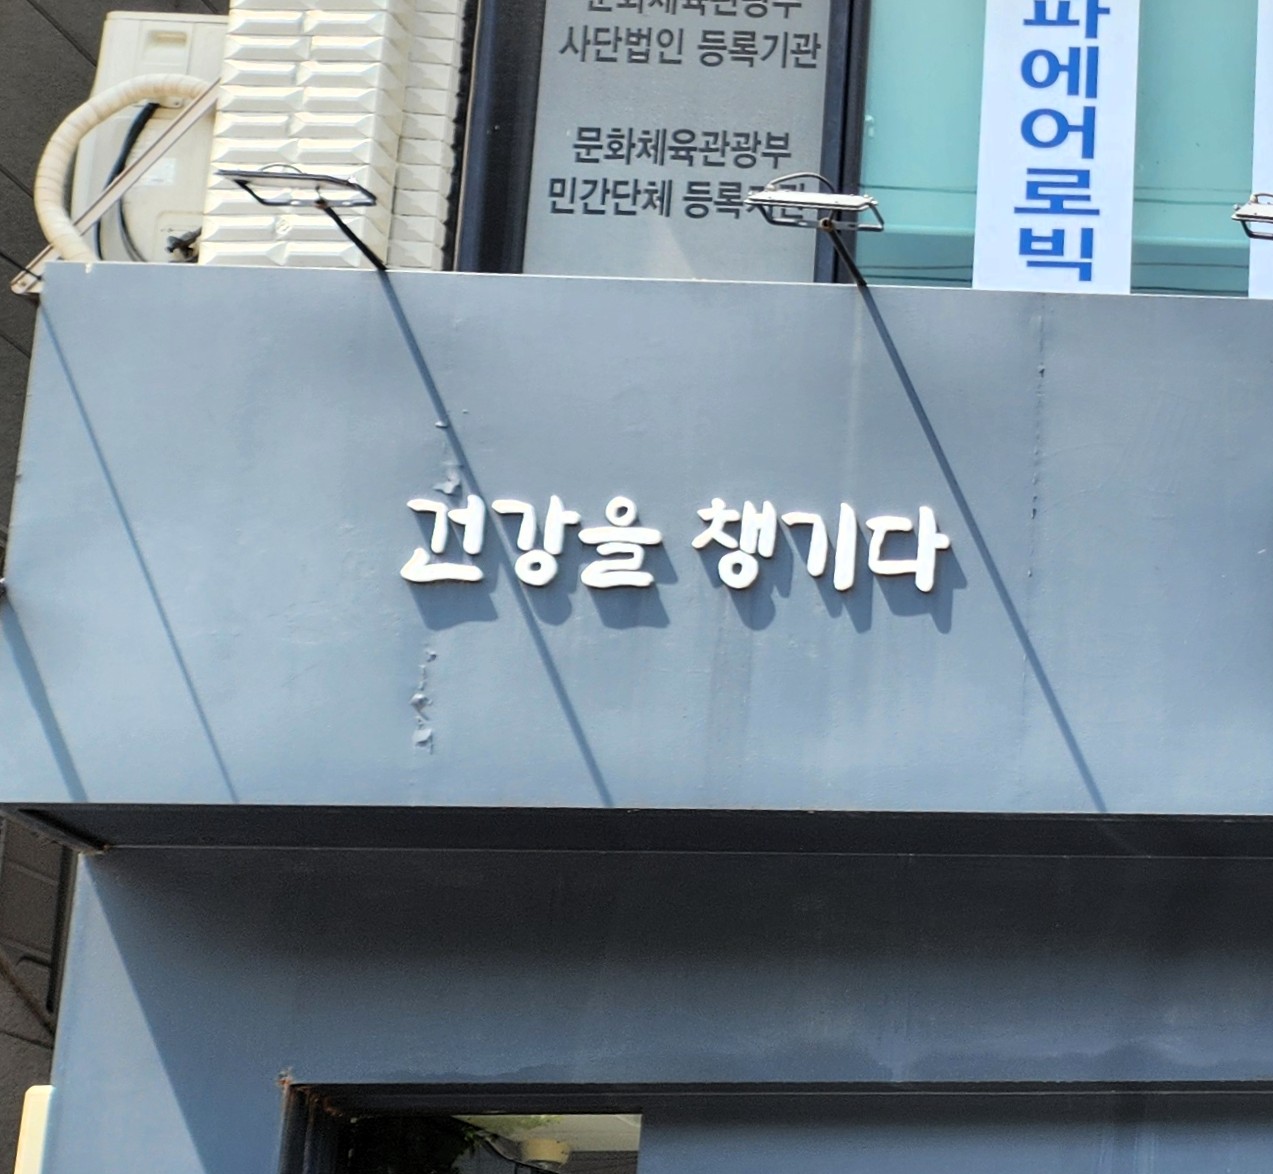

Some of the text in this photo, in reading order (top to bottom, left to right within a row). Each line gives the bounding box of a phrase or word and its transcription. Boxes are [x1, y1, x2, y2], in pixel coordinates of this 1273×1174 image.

[558, 25, 822, 69] 사단법인 등록기관
[573, 127, 792, 169] 문화체육관광부
[548, 177, 673, 217] 민간단체
[399, 494, 951, 593] 건강을 챙기다
